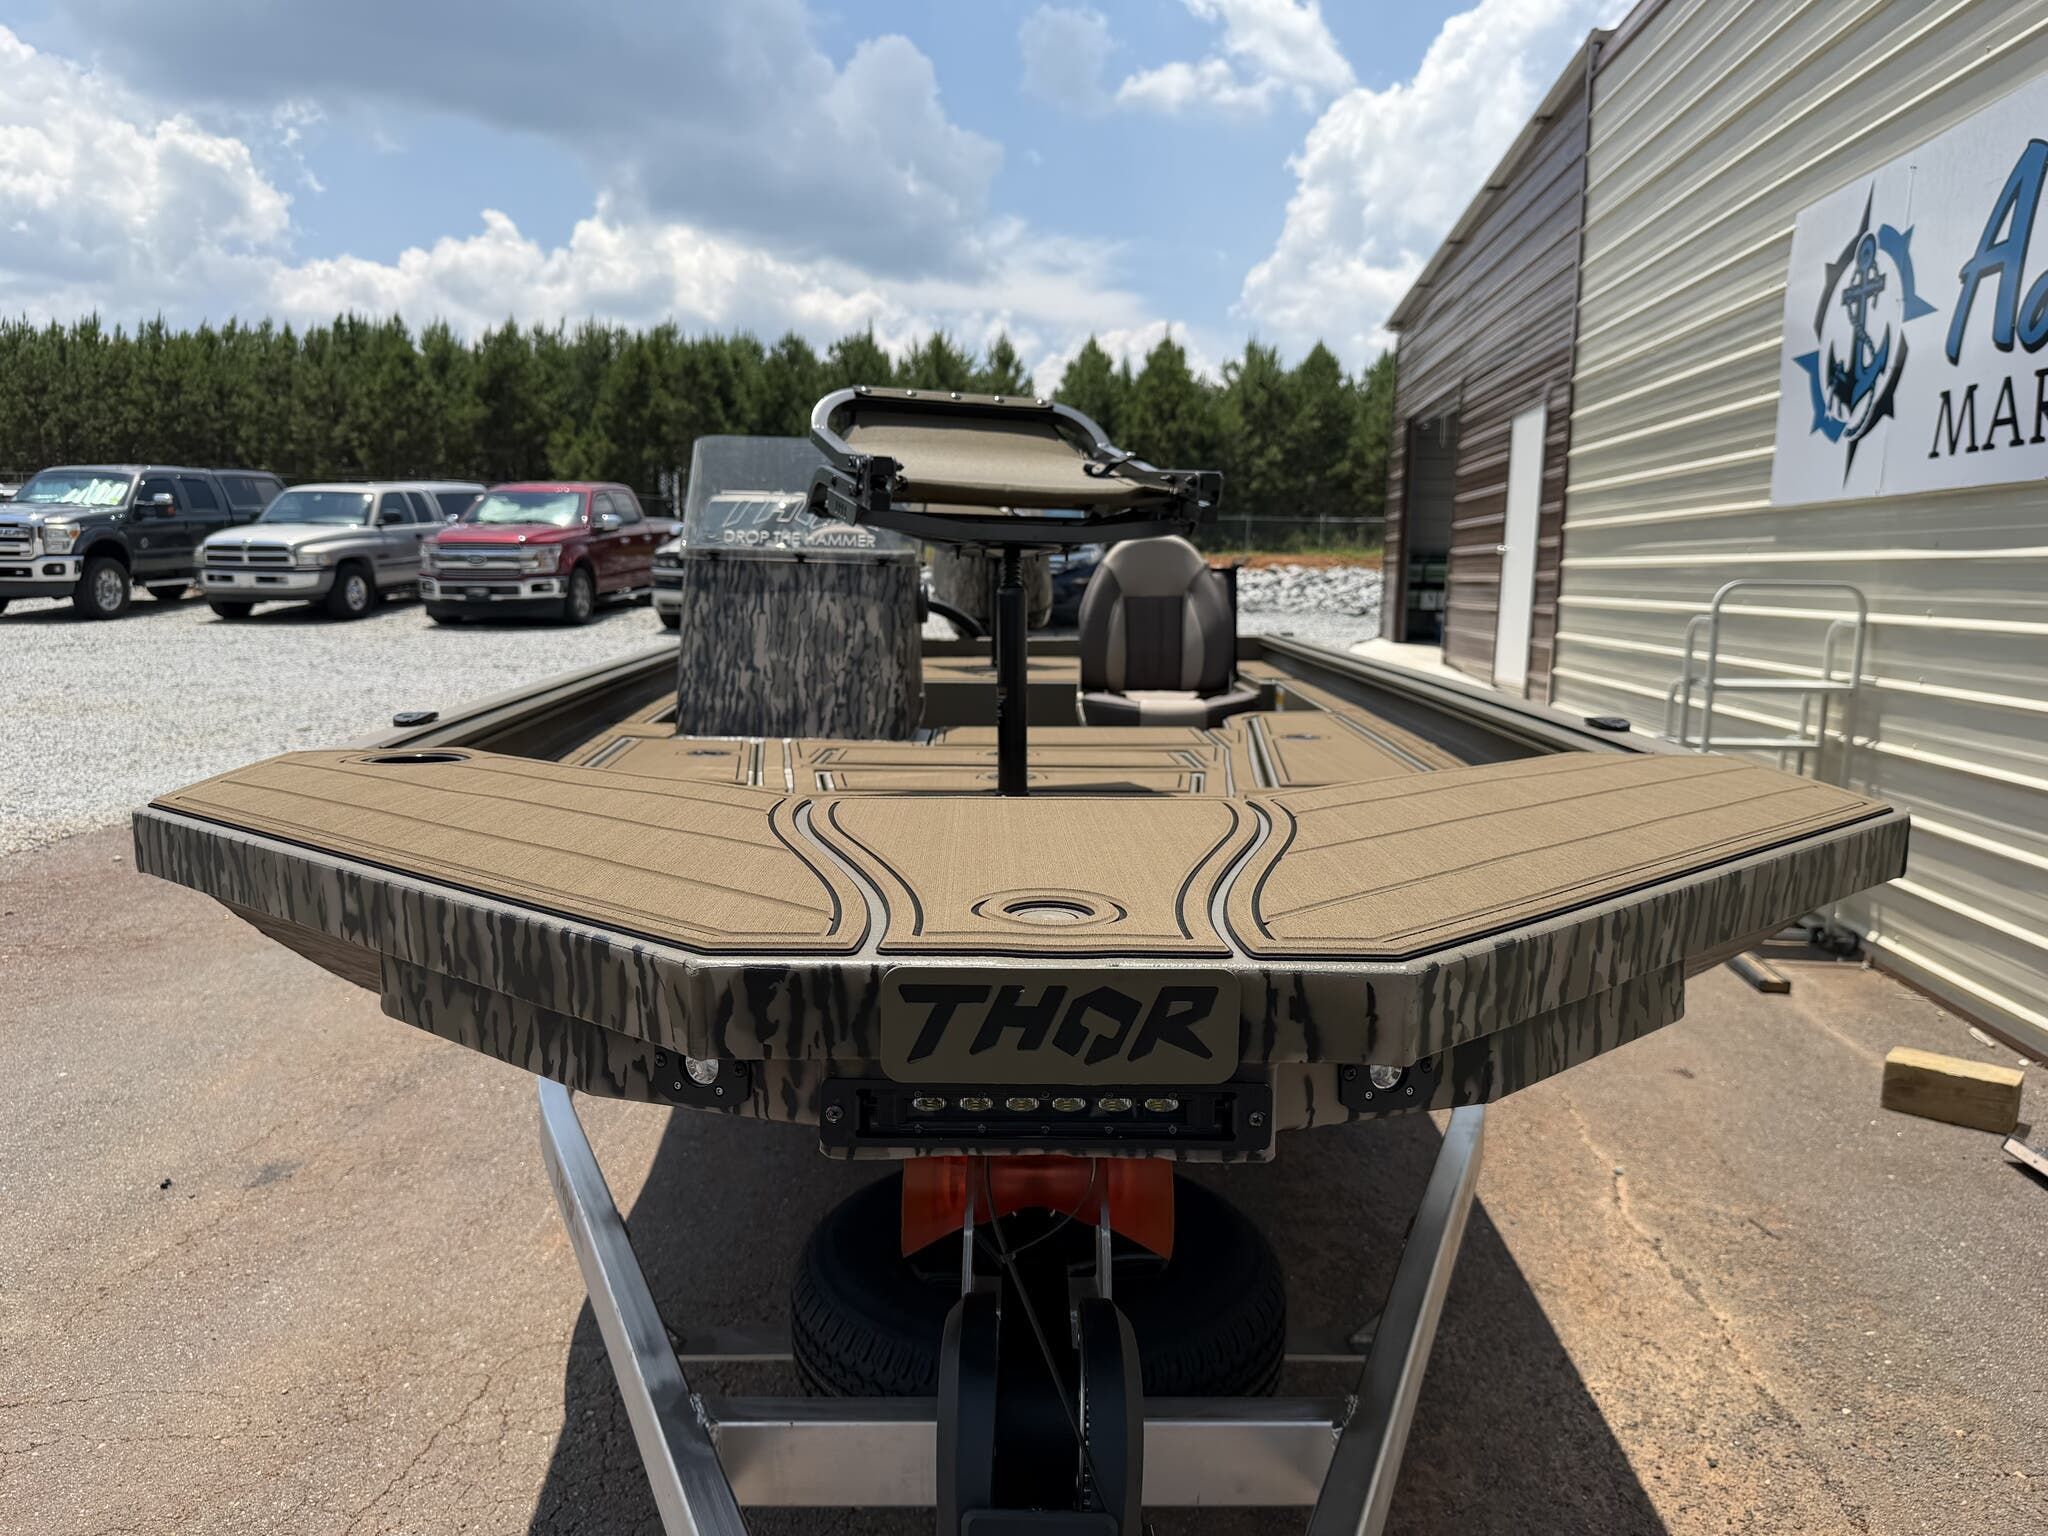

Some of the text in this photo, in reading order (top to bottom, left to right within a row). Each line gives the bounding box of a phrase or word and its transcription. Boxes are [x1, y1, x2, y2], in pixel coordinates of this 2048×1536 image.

[724, 530, 876, 548] DROP THE HAMMER
[899, 985, 1219, 1065] THOR
